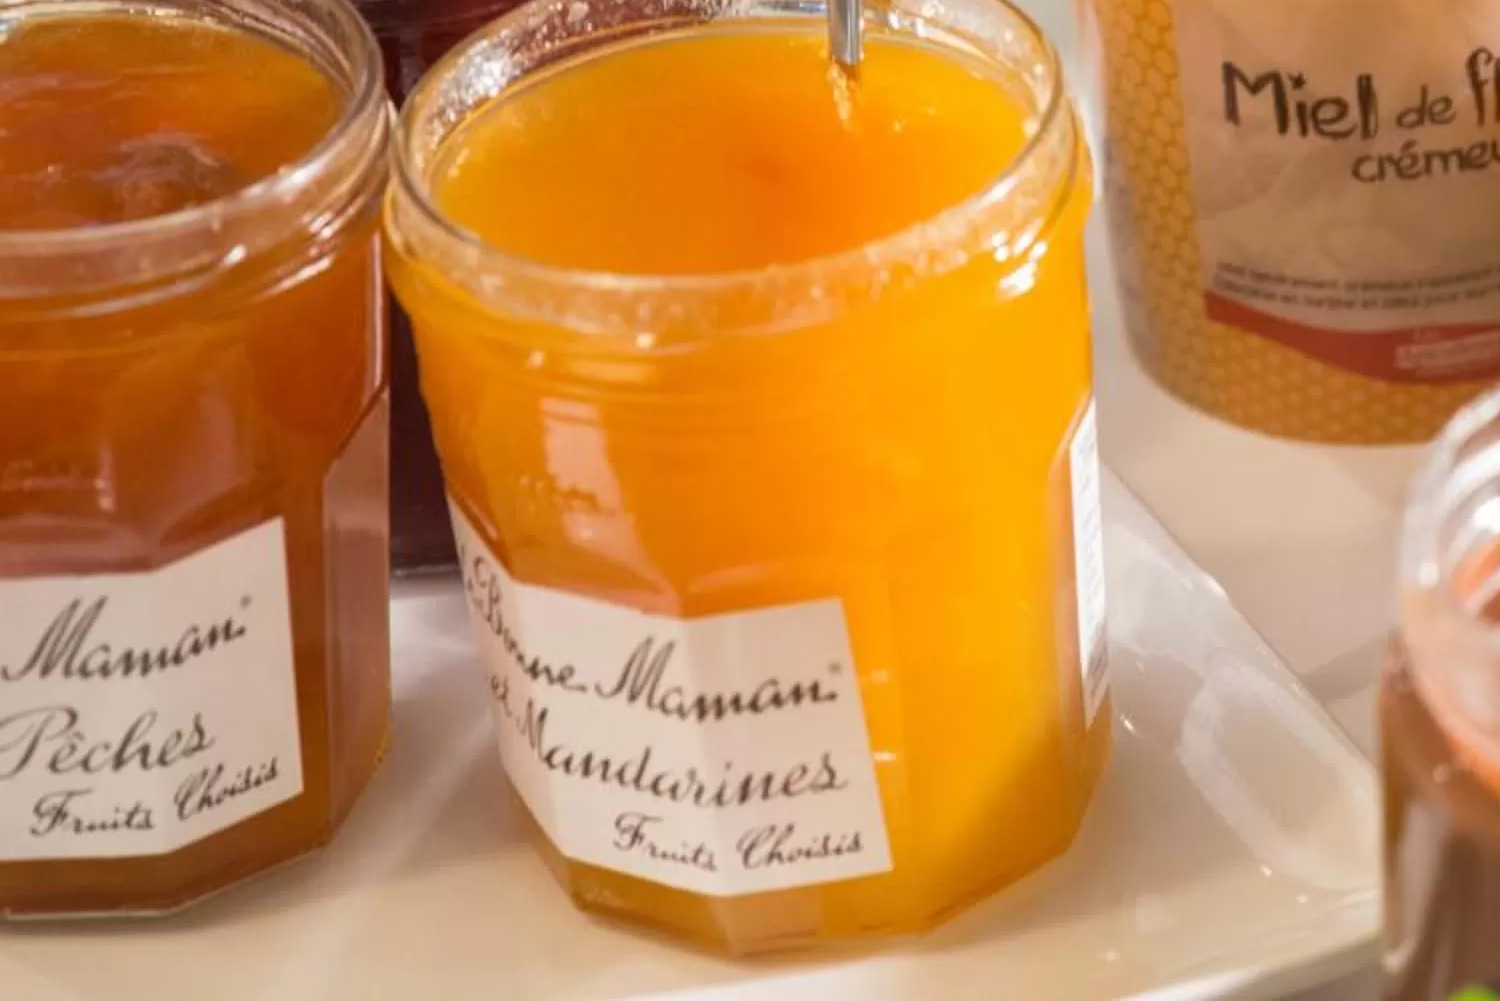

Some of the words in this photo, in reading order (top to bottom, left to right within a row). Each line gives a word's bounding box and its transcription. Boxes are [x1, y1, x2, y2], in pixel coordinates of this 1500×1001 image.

[1221, 61, 1379, 140] Miel
[1395, 84, 1457, 130] de
[0, 704, 216, 781] Pêches
[516, 699, 848, 808] Mandarines
[30, 787, 156, 837] Fruits
[174, 755, 280, 822] Choisis
[612, 811, 718, 873] Fruits
[736, 822, 864, 871] Choisis
